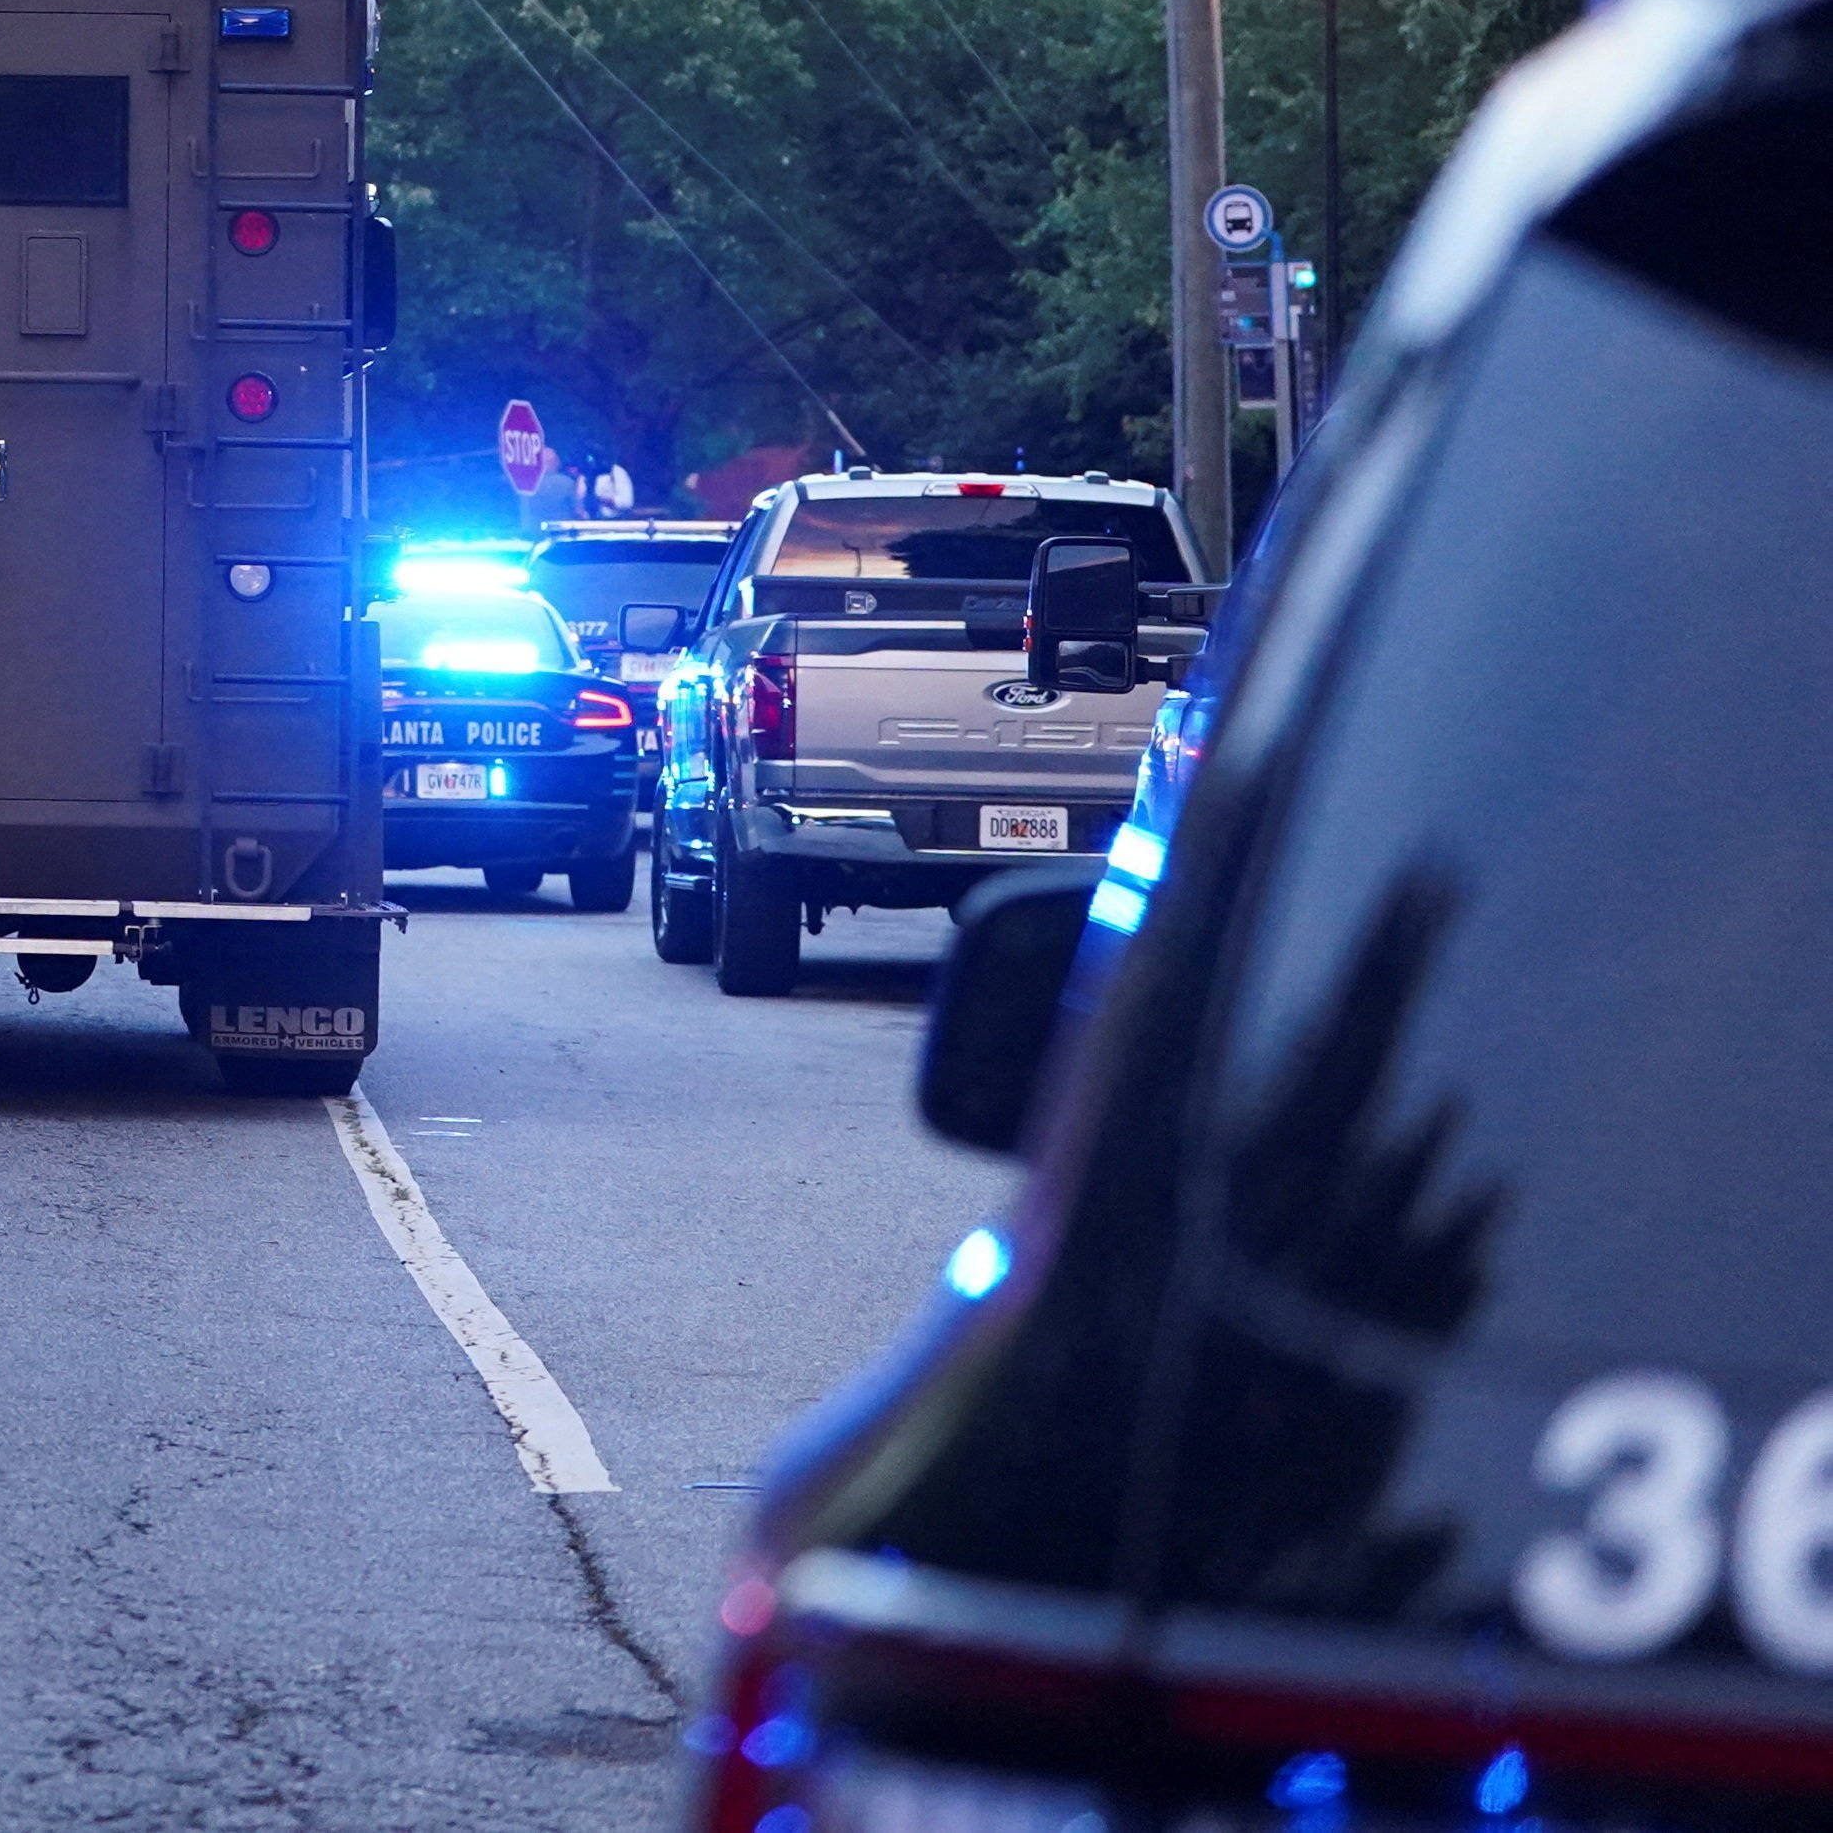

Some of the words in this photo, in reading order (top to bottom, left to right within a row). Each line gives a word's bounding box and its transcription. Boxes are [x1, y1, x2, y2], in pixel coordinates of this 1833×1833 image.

[504, 429, 541, 465] STOP
[1004, 685, 1048, 704] Ford
[467, 722, 541, 746] POLICE
[210, 1005, 365, 1035] LENCO
[213, 1035, 277, 1046] ARMORED
[297, 1036, 364, 1048] VEHICLES
